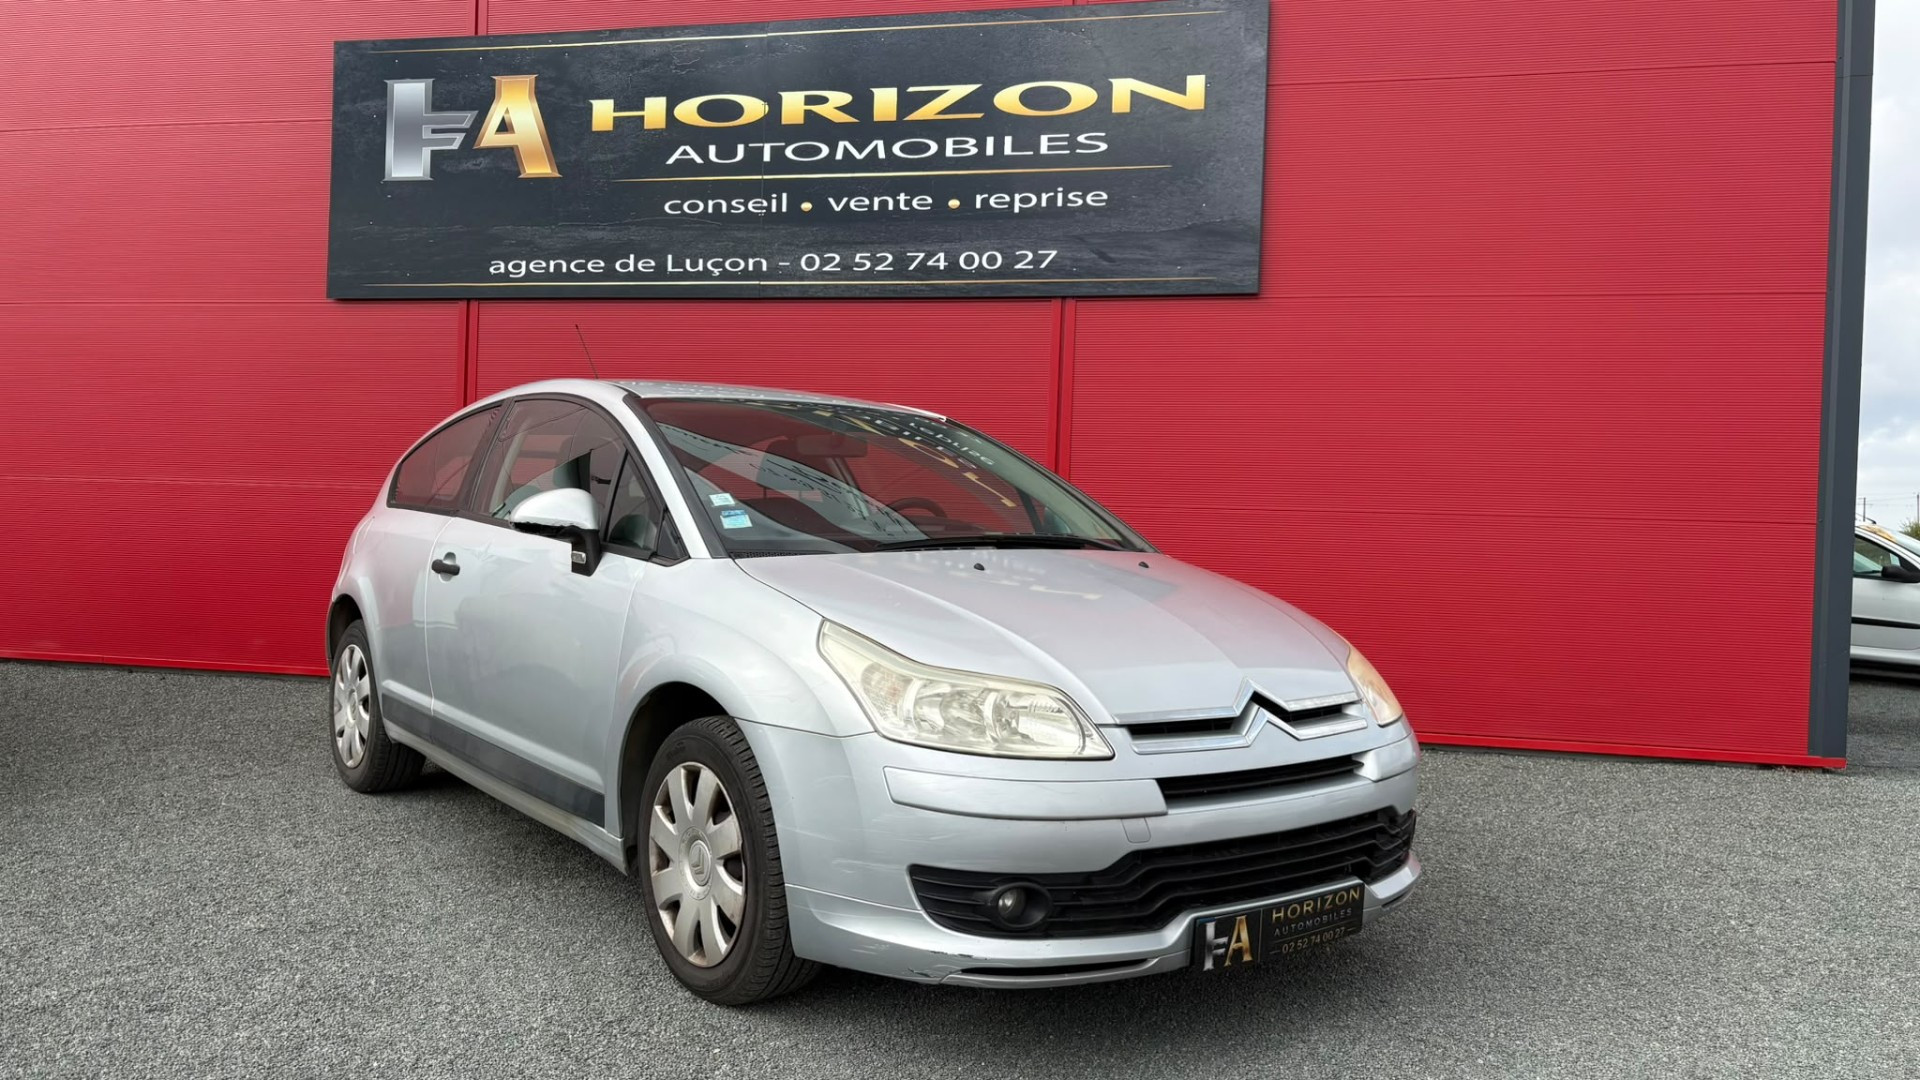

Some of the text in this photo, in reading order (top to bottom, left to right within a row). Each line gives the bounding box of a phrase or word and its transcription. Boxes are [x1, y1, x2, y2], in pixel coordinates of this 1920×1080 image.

[589, 75, 1206, 132] HORIZON
[665, 132, 1109, 165] AUTOMOBILES
[664, 187, 1108, 215] conseil vente reprise
[488, 260, 605, 280] agence
[614, 254, 656, 274] de
[667, 253, 768, 277] Luçon
[800, 253, 842, 271] 02
[852, 253, 895, 271] 52
[906, 252, 949, 270] 74
[959, 251, 1003, 270] 00
[1014, 250, 1058, 269] 27
[1272, 887, 1361, 924] HORIZON
[1273, 908, 1352, 937] AUTOMOBILES
